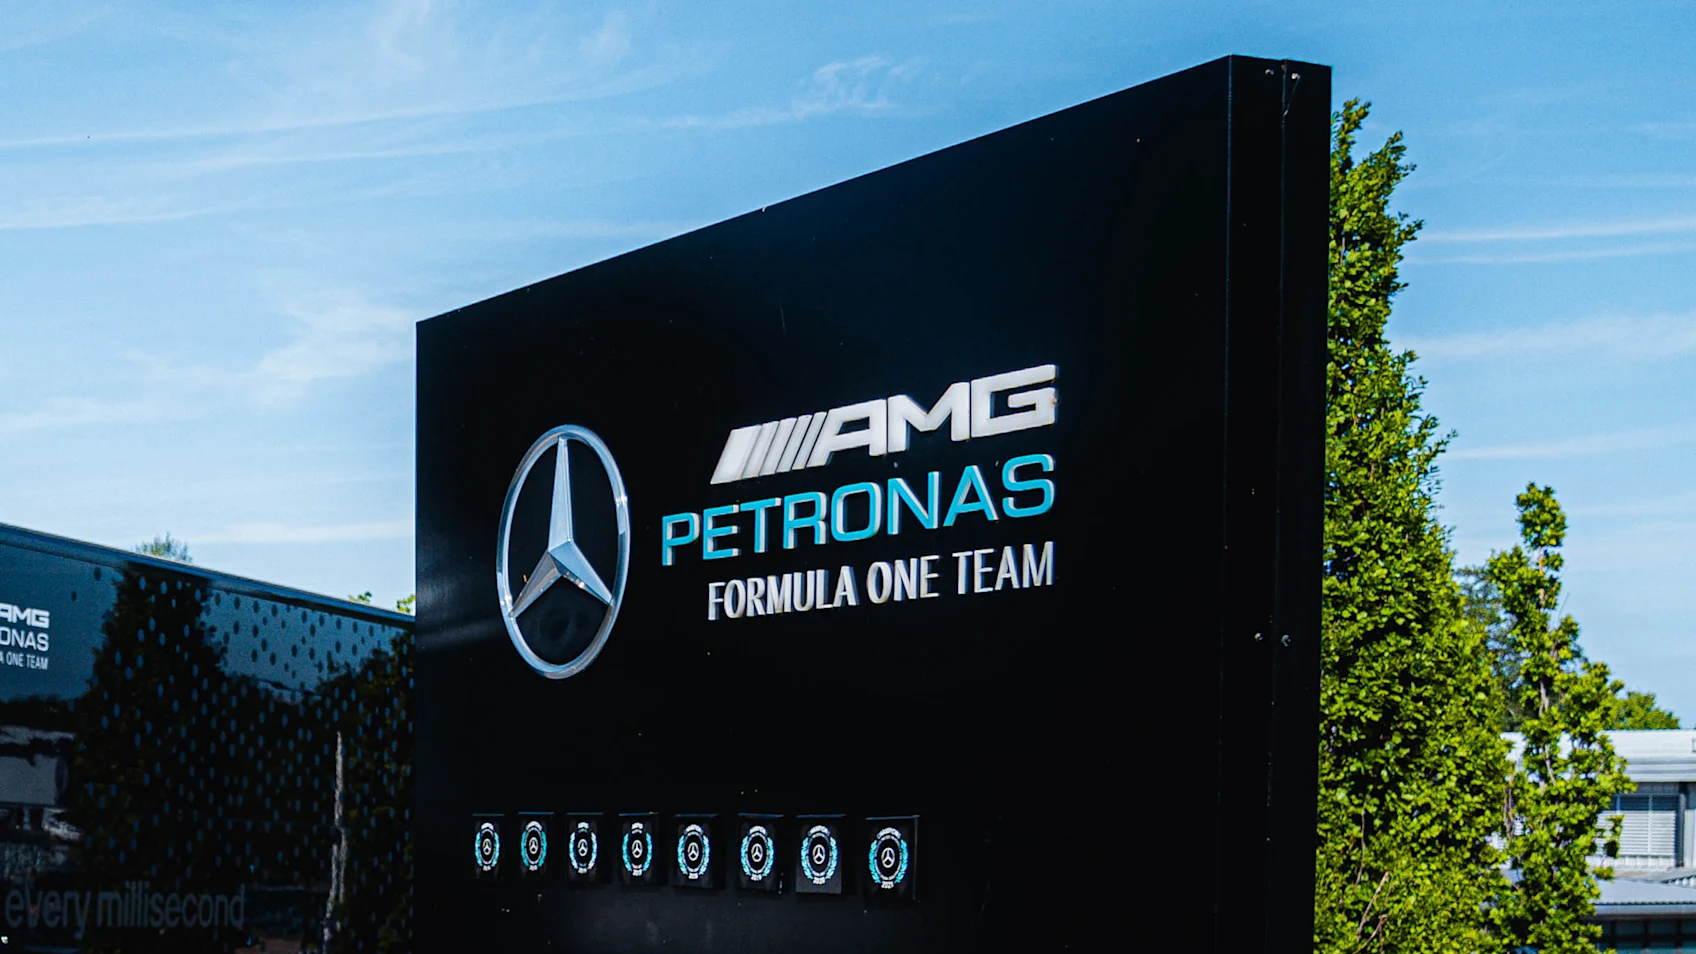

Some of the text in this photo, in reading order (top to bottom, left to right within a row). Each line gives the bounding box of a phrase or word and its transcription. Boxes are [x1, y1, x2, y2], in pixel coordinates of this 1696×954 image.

[806, 364, 1057, 468] AMG
[662, 453, 1056, 566] PETRONAS
[707, 541, 1055, 621] FORMULA ONE TEAM
[5, 651, 25, 668] ONE
[26, 653, 49, 671] TEAM
[4, 885, 92, 939] every
[96, 880, 245, 929] millisecond
